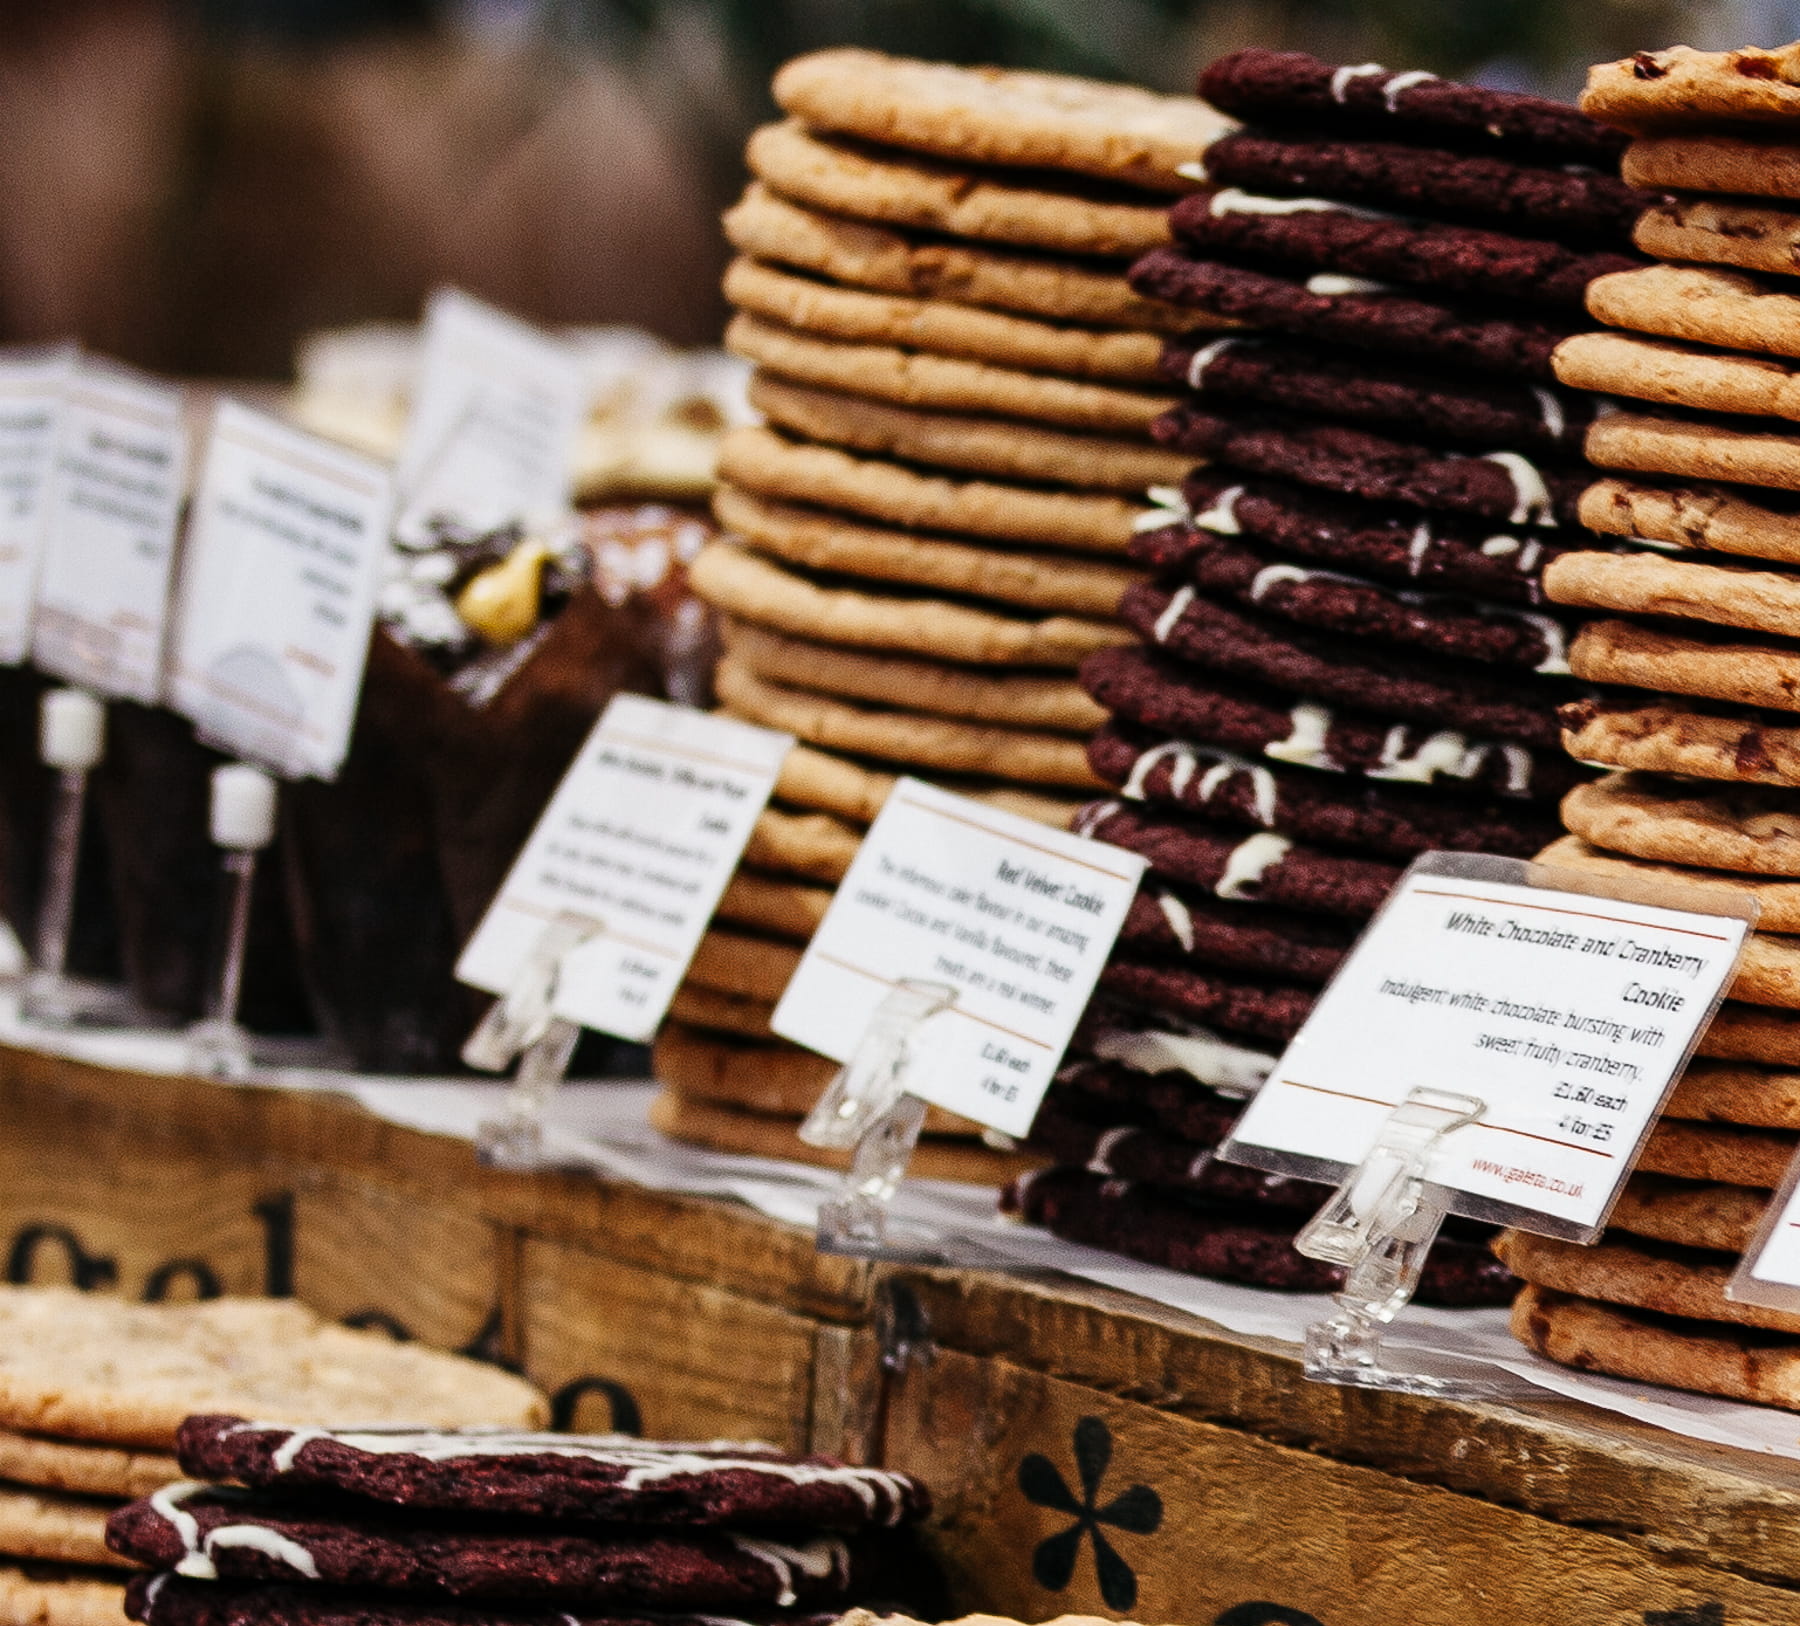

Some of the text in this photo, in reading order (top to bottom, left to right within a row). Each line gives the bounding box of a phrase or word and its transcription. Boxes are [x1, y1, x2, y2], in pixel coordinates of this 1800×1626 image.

[1446, 912, 1710, 978] White Chocolate and Cranberry
[1379, 979, 1666, 1048] Indulgent white chocolate bursting with
[1623, 982, 1685, 1012] Cookie
[1473, 1032, 1521, 1054] sweet
[1524, 1038, 1564, 1067] fruity
